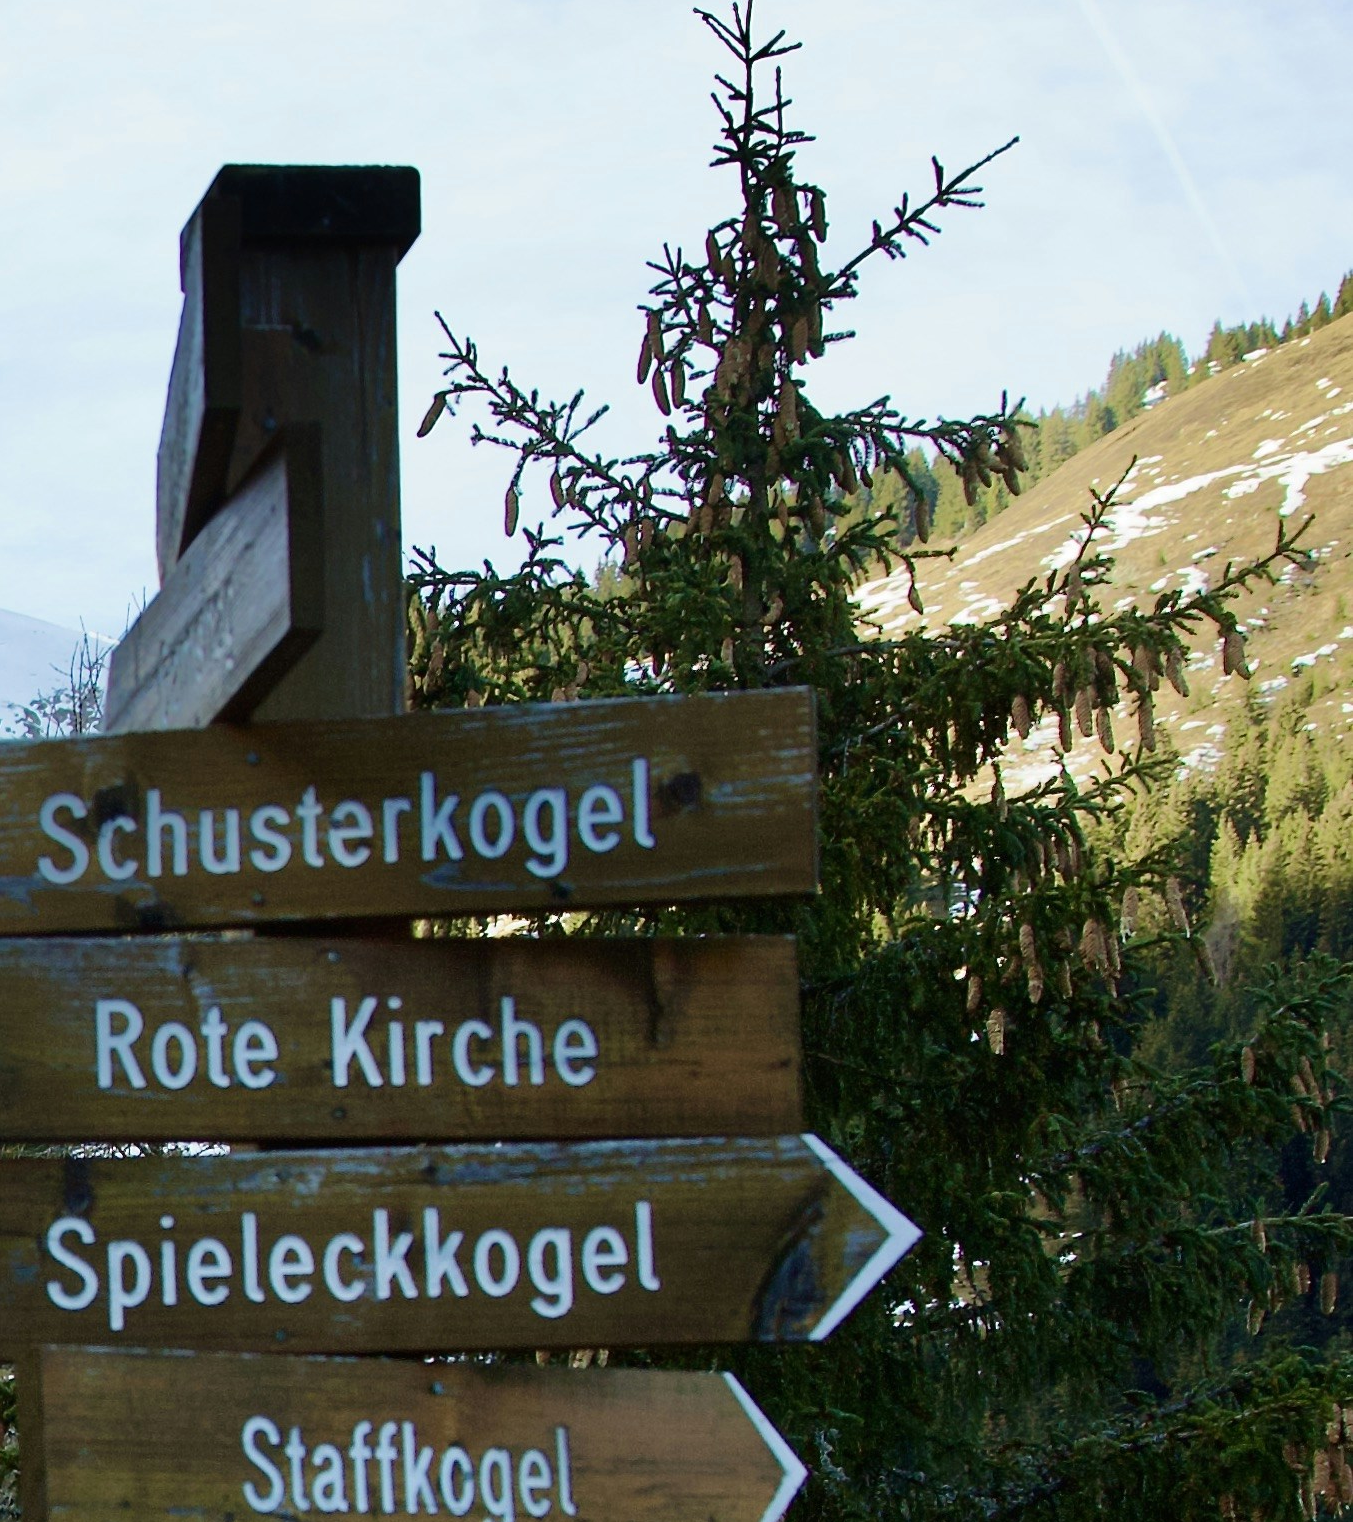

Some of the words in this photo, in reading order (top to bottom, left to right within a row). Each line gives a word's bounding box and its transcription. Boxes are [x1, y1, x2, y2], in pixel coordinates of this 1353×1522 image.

[37, 758, 656, 886] Schusterkogel
[96, 998, 281, 1091] Rote
[330, 995, 599, 1089] Kirche
[46, 1200, 661, 1332] Spieleckkogel
